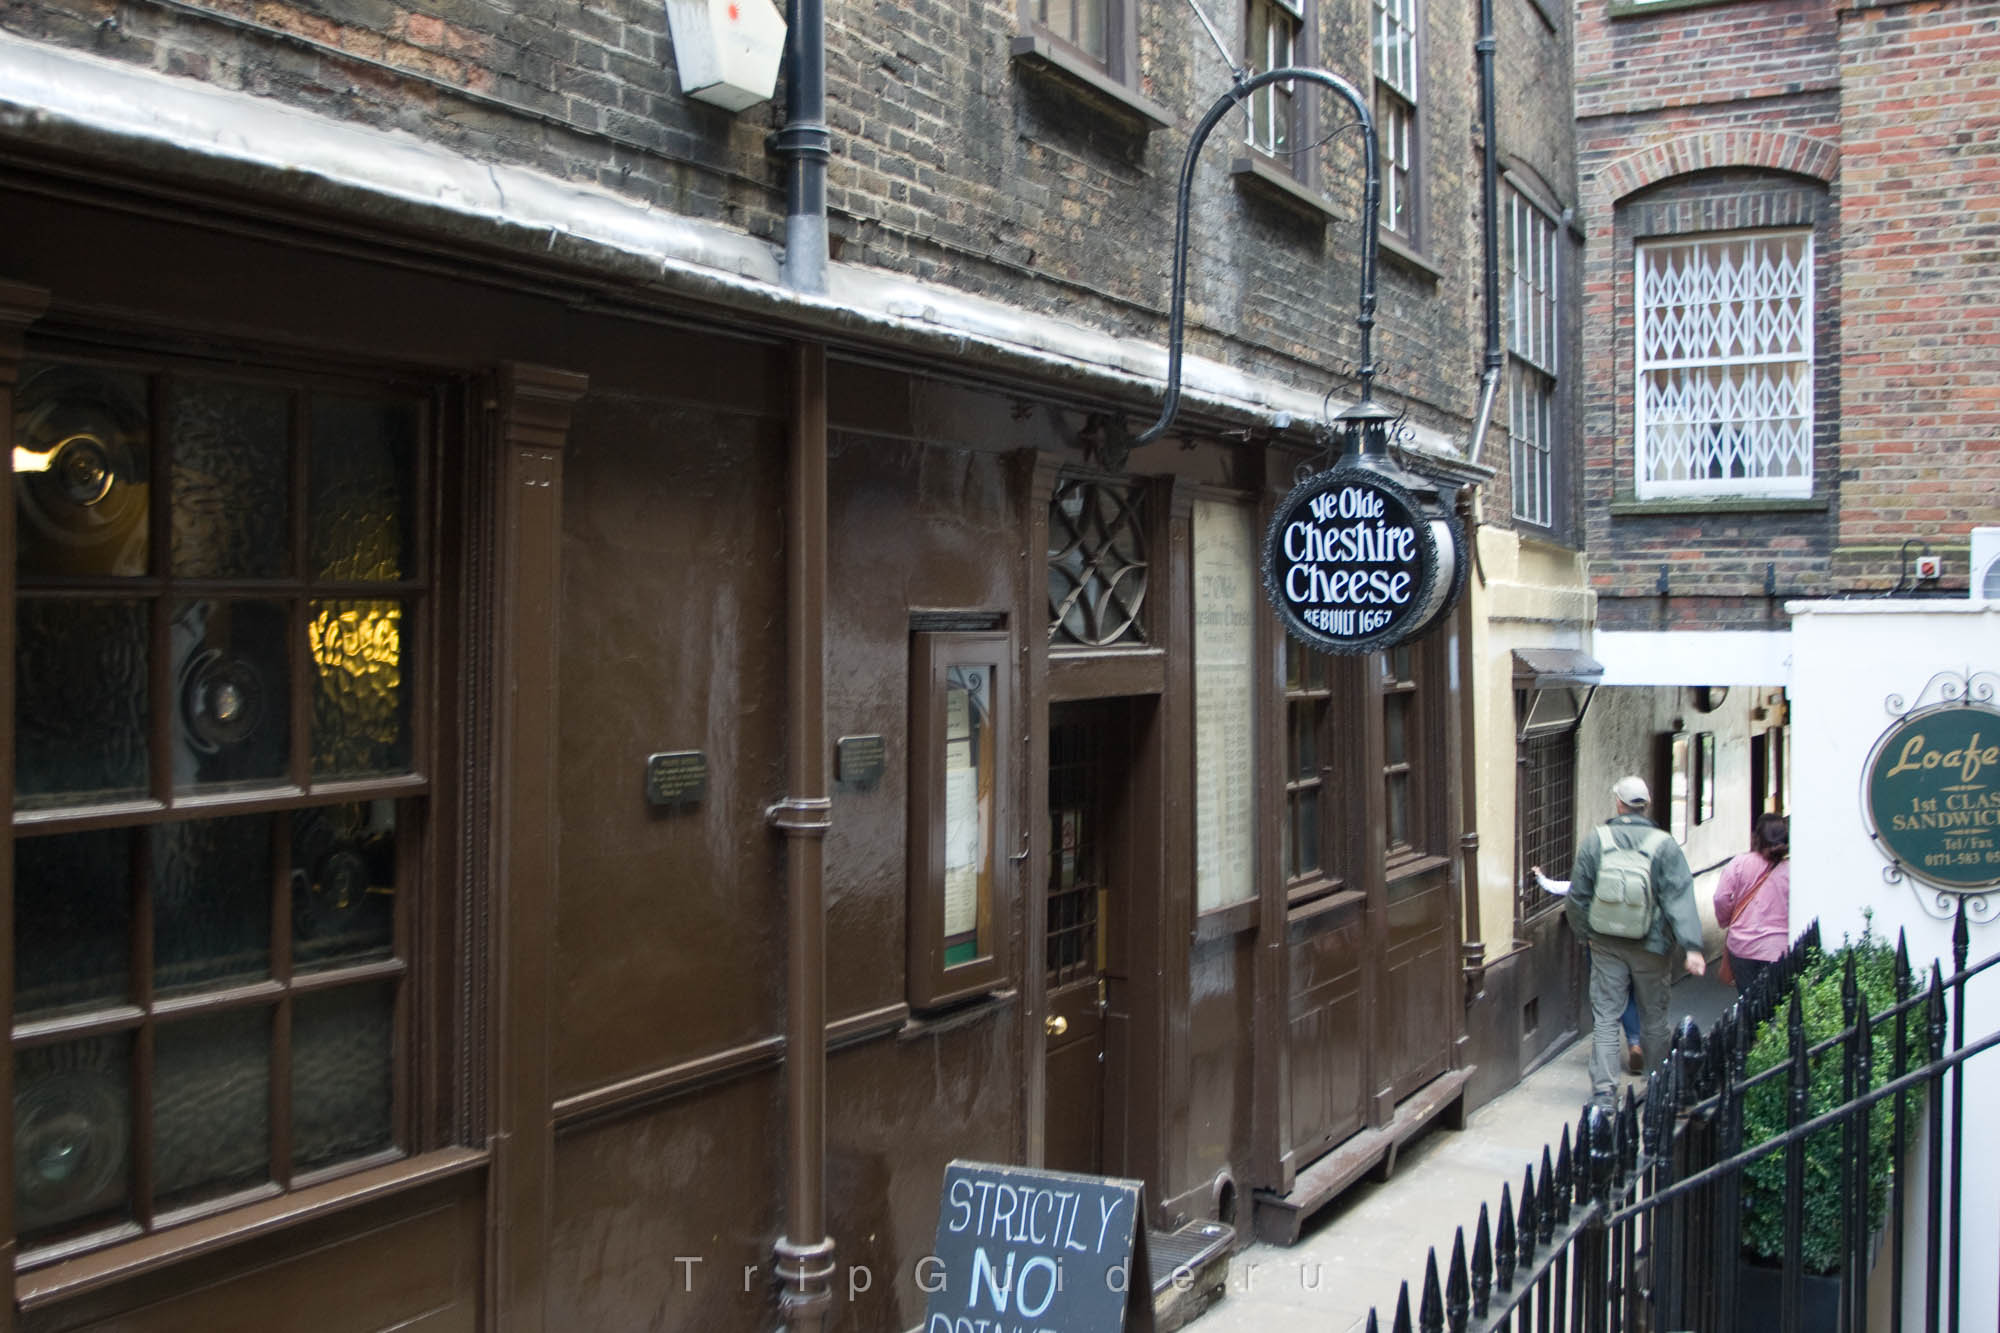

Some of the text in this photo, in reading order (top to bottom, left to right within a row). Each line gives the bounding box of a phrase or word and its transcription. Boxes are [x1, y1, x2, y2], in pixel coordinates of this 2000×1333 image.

[1339, 487, 1384, 519] Olde
[1284, 519, 1416, 562] Cheshire
[1285, 563, 1411, 604] Cheese
[1304, 608, 1393, 635] REBUILT 1667
[1892, 809, 2000, 831] SANDWIC
[1911, 796, 1936, 813] 1st
[949, 1178, 1123, 1254] STRICTLY
[968, 1247, 1057, 1318] NO
